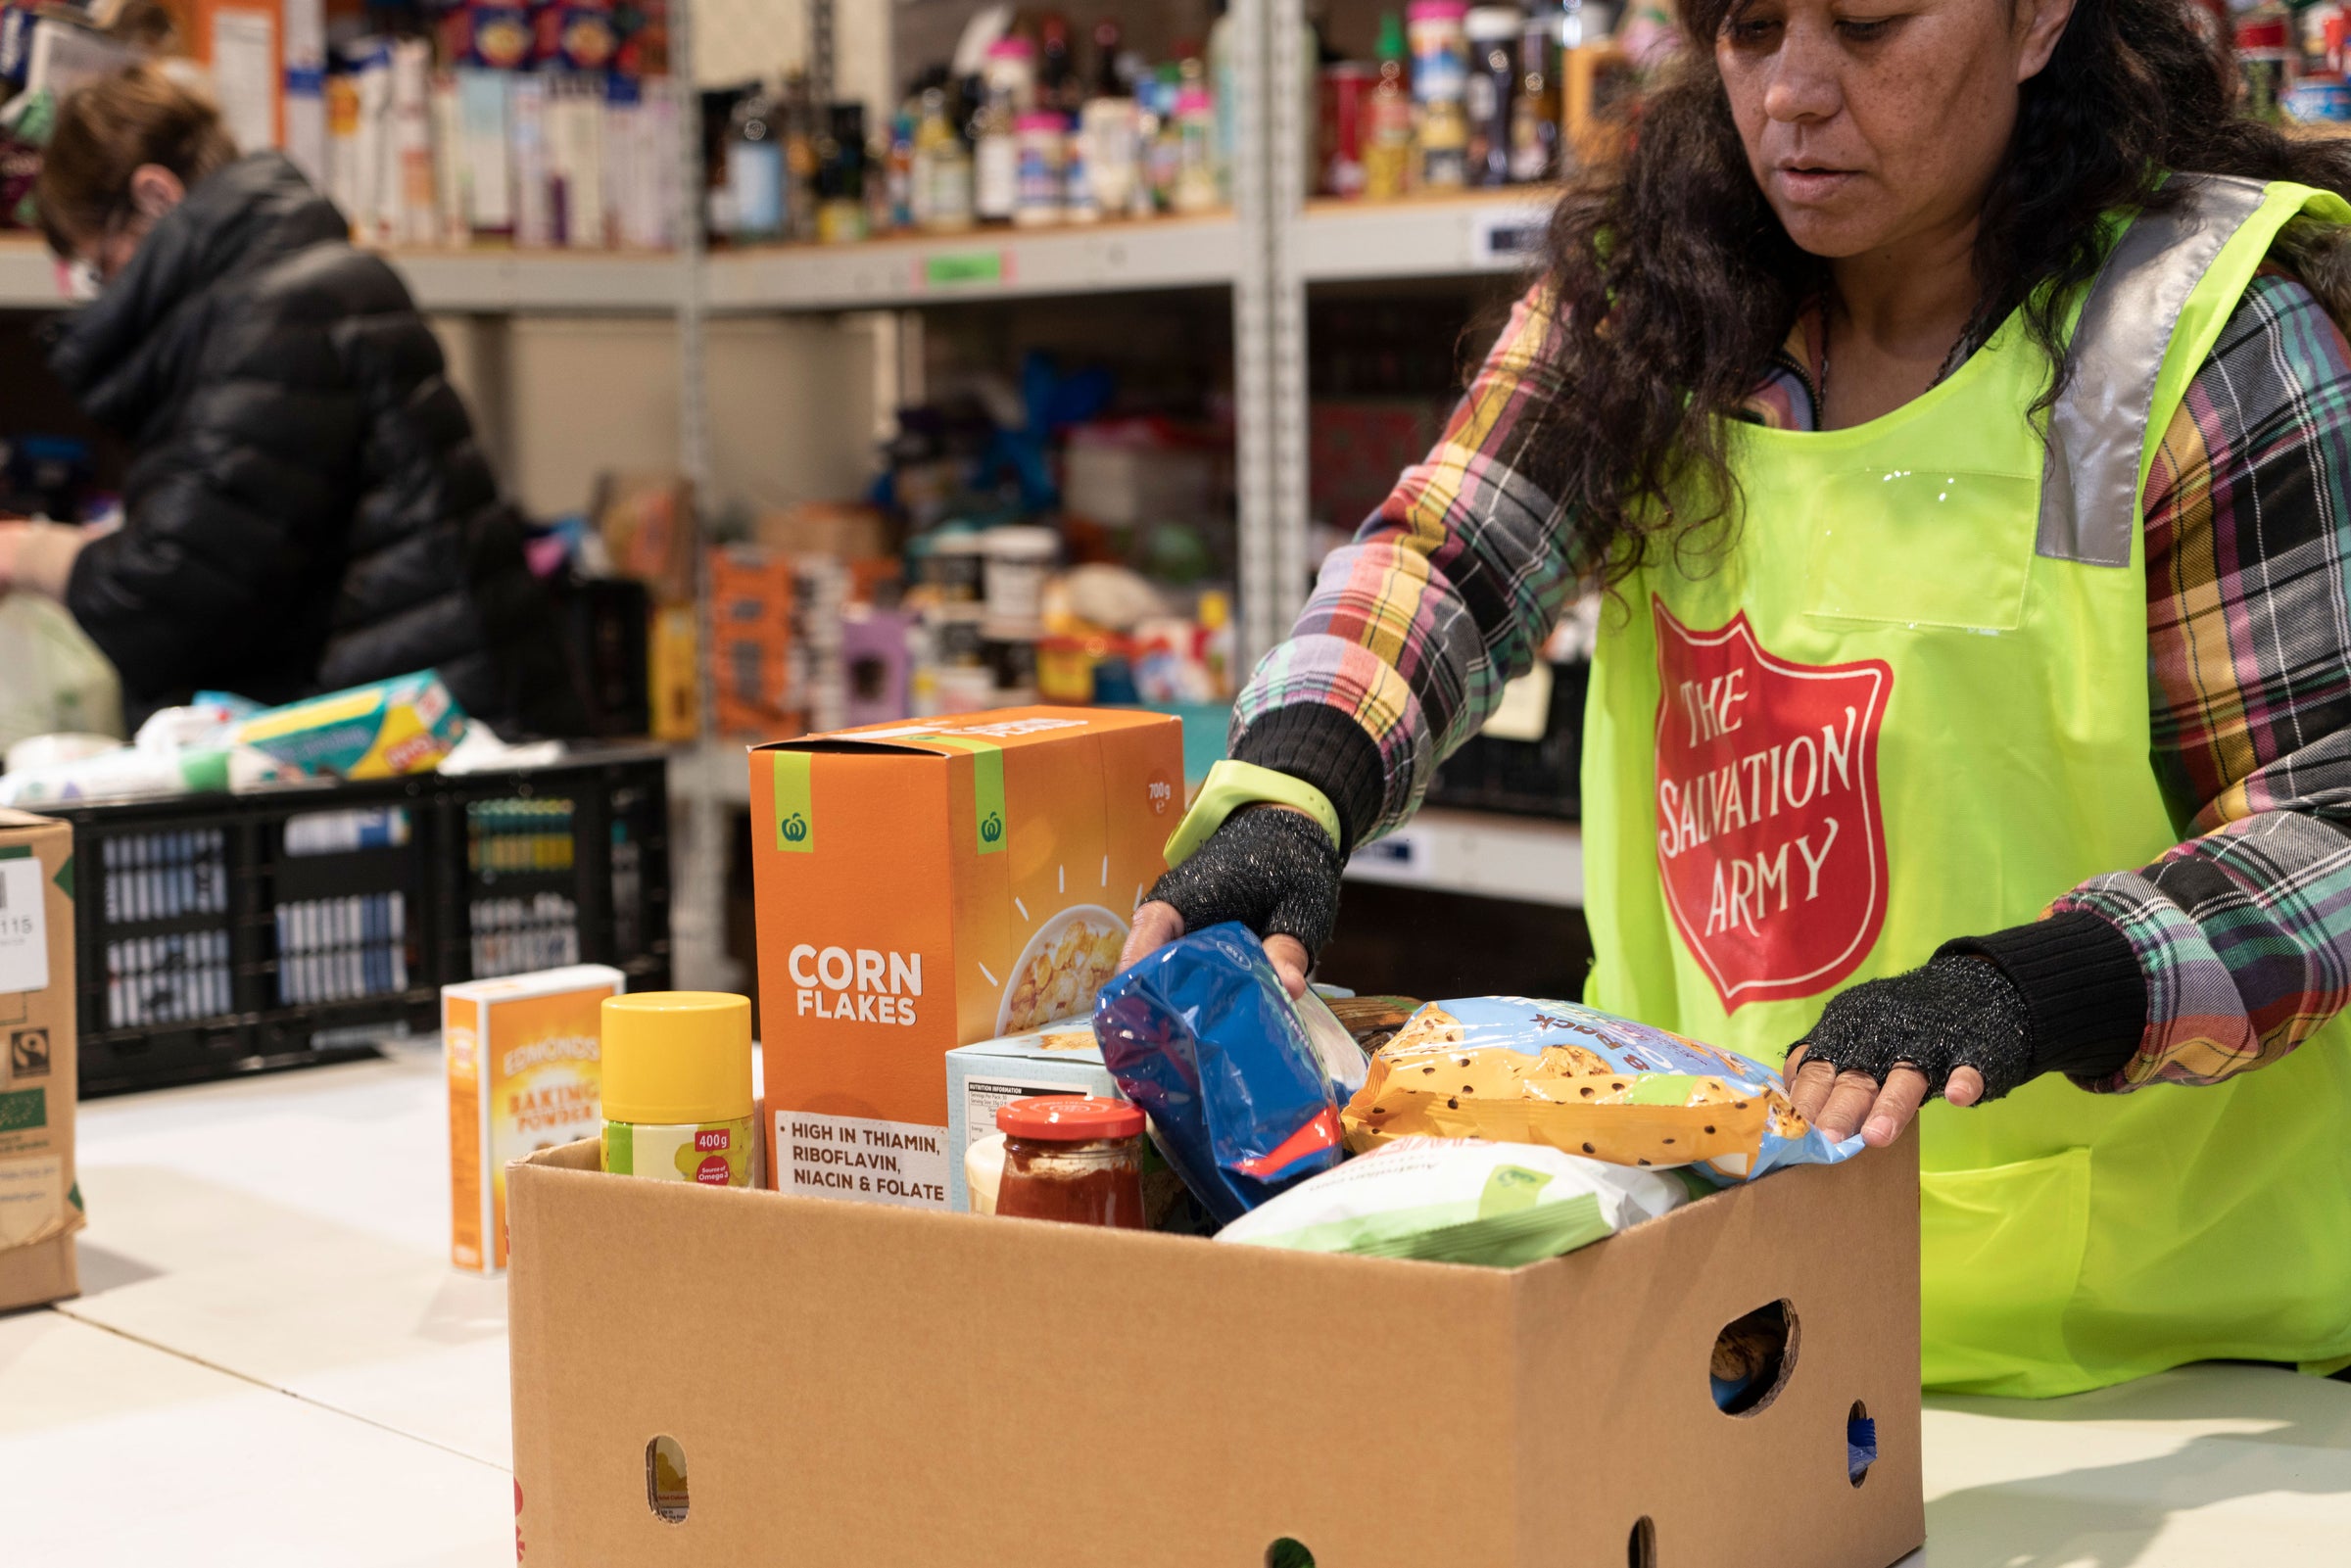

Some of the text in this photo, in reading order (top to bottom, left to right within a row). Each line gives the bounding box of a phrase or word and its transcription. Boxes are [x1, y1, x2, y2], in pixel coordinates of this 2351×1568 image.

[1679, 668, 1749, 749] THE
[1659, 705, 1857, 859] SALVATION
[1704, 816, 1840, 938] ARMY
[788, 943, 923, 997] CORN
[796, 988, 918, 1026] FLAKES
[1528, 1013, 1623, 1051] Pack
[503, 1035, 600, 1077] EDMONDS
[1622, 1053, 1651, 1071] 8
[792, 1121, 940, 1156] HIGH IN THIAMIN,
[698, 1172, 723, 1181] Omega
[792, 1145, 901, 1174] RIBOFLAVIN,
[793, 1167, 944, 1202] NIACIN & FOLATE
